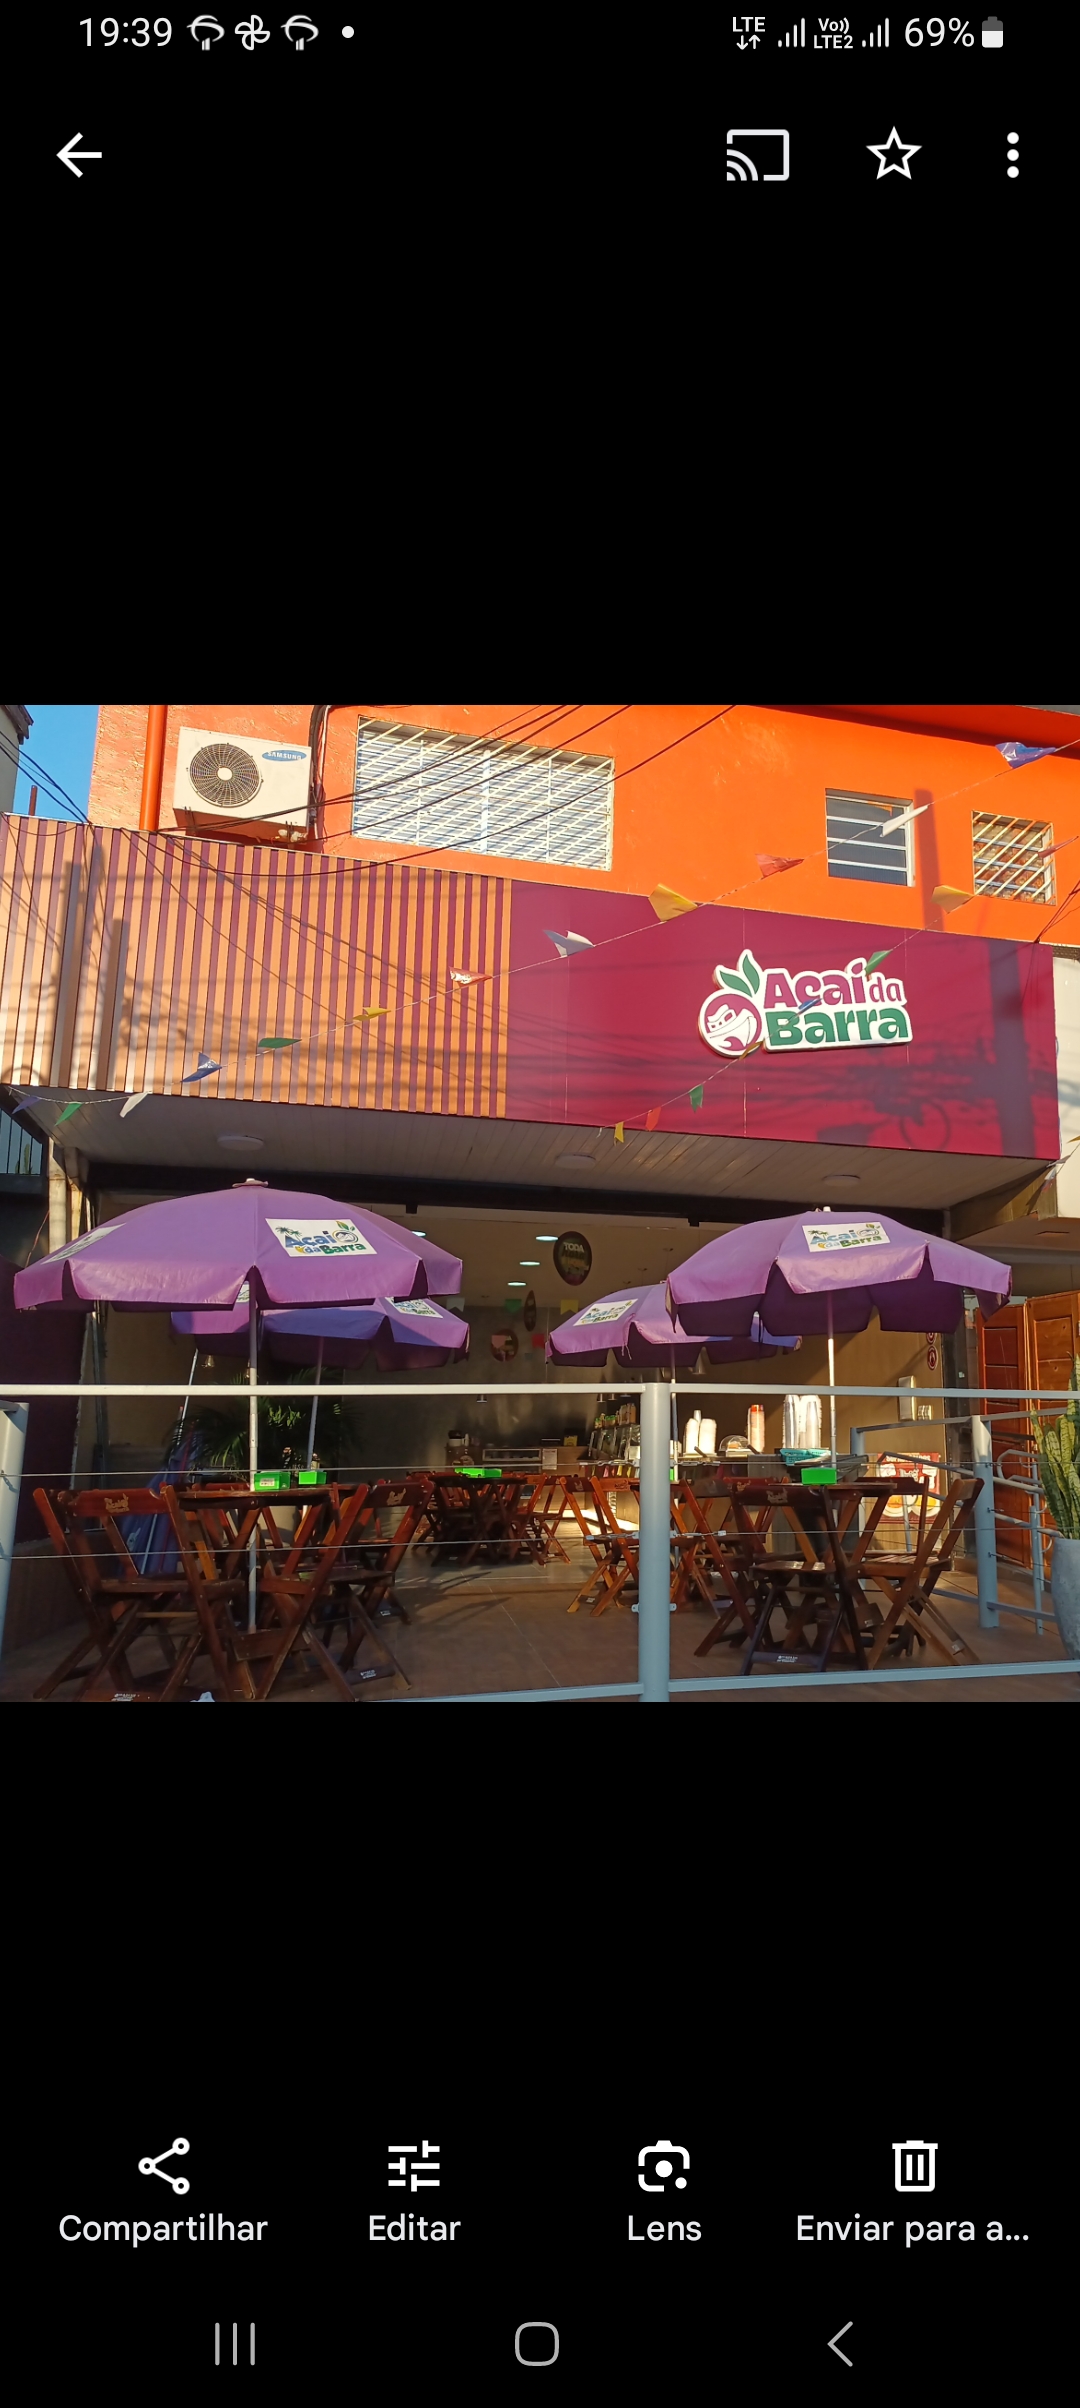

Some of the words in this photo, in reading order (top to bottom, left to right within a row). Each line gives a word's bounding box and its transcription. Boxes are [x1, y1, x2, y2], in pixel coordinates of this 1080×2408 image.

[869, 976, 901, 1003] da
[765, 1007, 909, 1046] Barra
[304, 1246, 321, 1254] da
[319, 1243, 366, 1255] Barra
[839, 1236, 882, 1248] Barra
